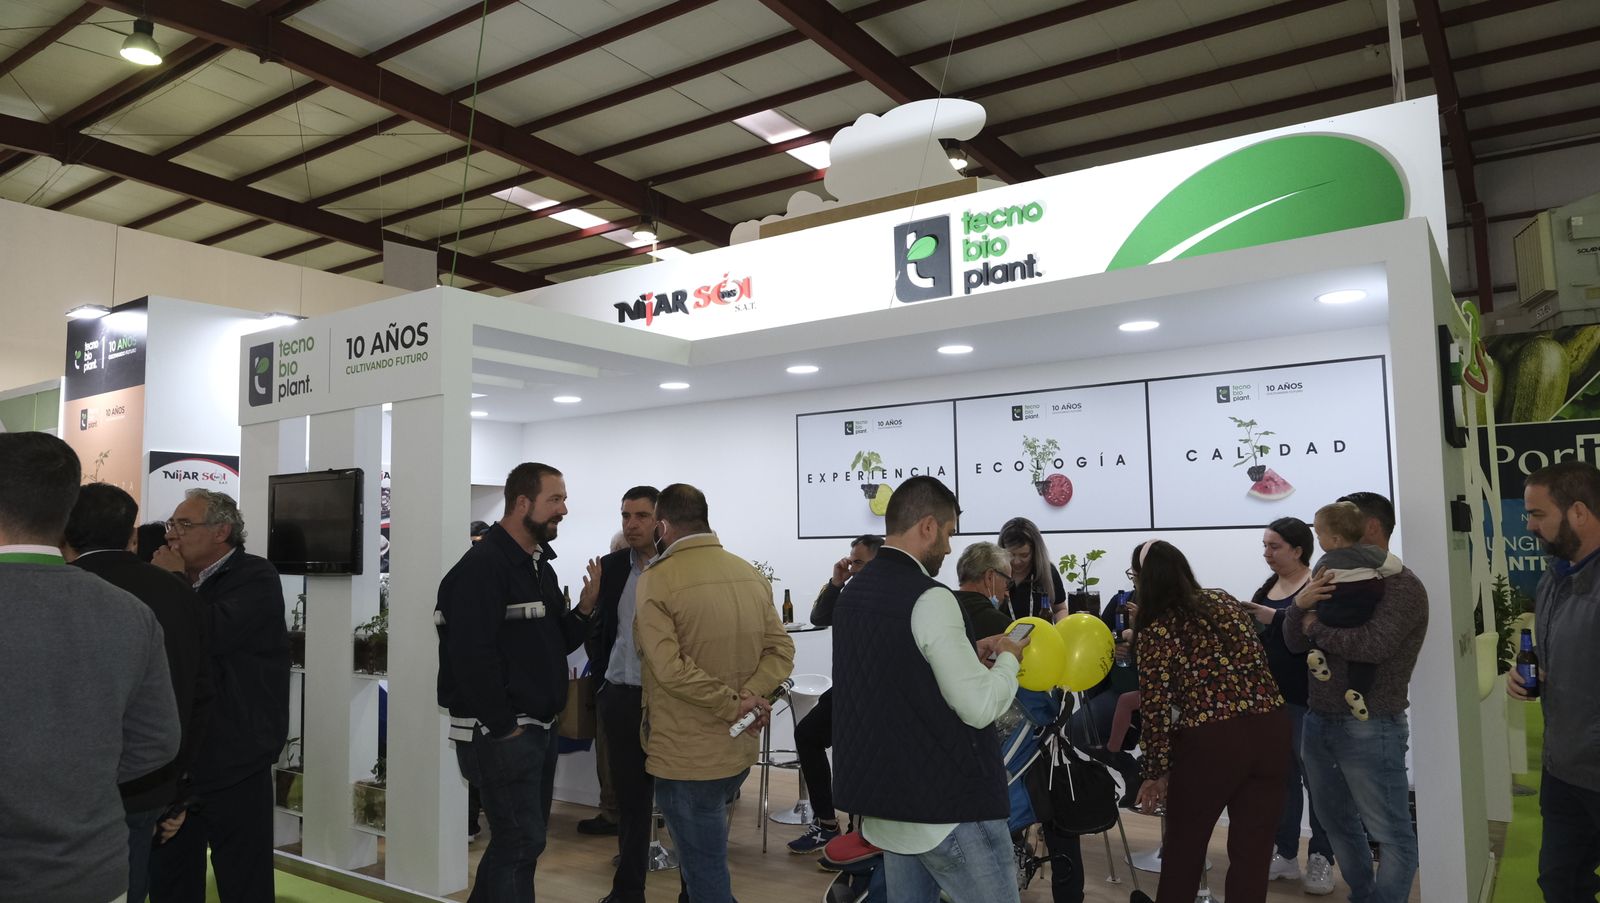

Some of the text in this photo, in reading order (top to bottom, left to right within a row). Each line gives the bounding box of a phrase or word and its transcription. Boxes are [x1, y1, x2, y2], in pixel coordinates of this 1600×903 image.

[961, 201, 1045, 235] tecno
[961, 234, 1009, 262] bio
[963, 253, 1043, 294] plant.
[108, 341, 117, 352] 10
[278, 336, 315, 358] tecno
[346, 322, 429, 360] 10 AÑOS
[278, 360, 298, 378] bio
[345, 351, 429, 375] CULTIVANDO FUTURO
[278, 374, 313, 402] plant.
[1266, 382, 1303, 392] 10 AÑOS
[1052, 402, 1082, 412] 10 AÑOS
[1185, 439, 1346, 462] CALIDAD
[975, 452, 1126, 474] ECOLOGÍA
[807, 465, 946, 484] EXPERIENCIA
